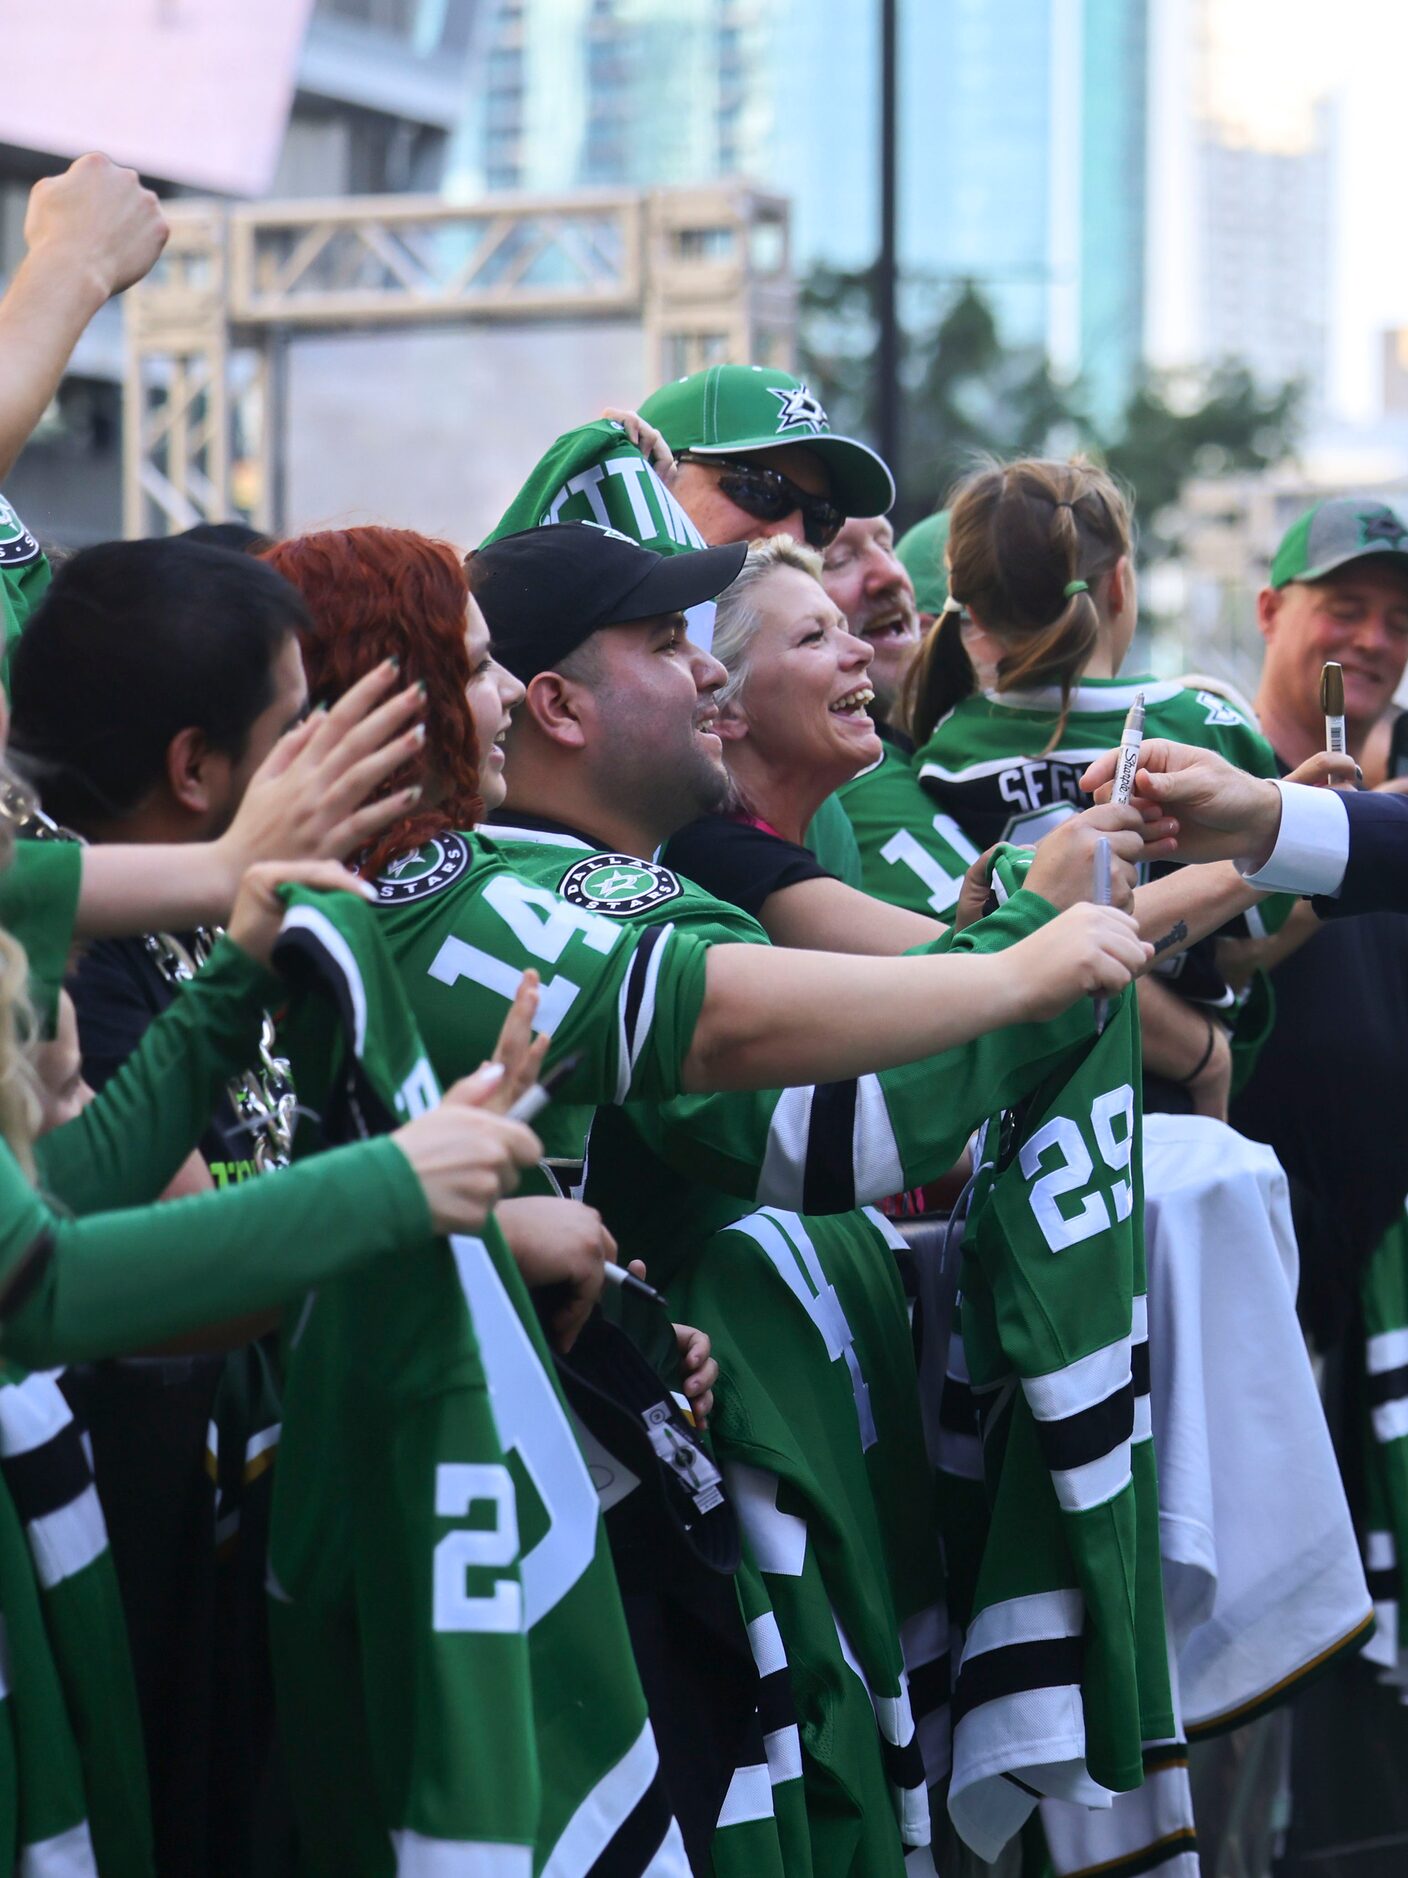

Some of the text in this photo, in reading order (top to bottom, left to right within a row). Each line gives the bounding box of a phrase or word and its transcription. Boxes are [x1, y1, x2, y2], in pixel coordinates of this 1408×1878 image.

[1119, 748, 1137, 793] Sharpie
[380, 849, 461, 897] STARS
[567, 857, 662, 895] DALLAS
[585, 885, 672, 909] STARS
[427, 874, 624, 1039] 14
[1019, 1083, 1134, 1254] 29
